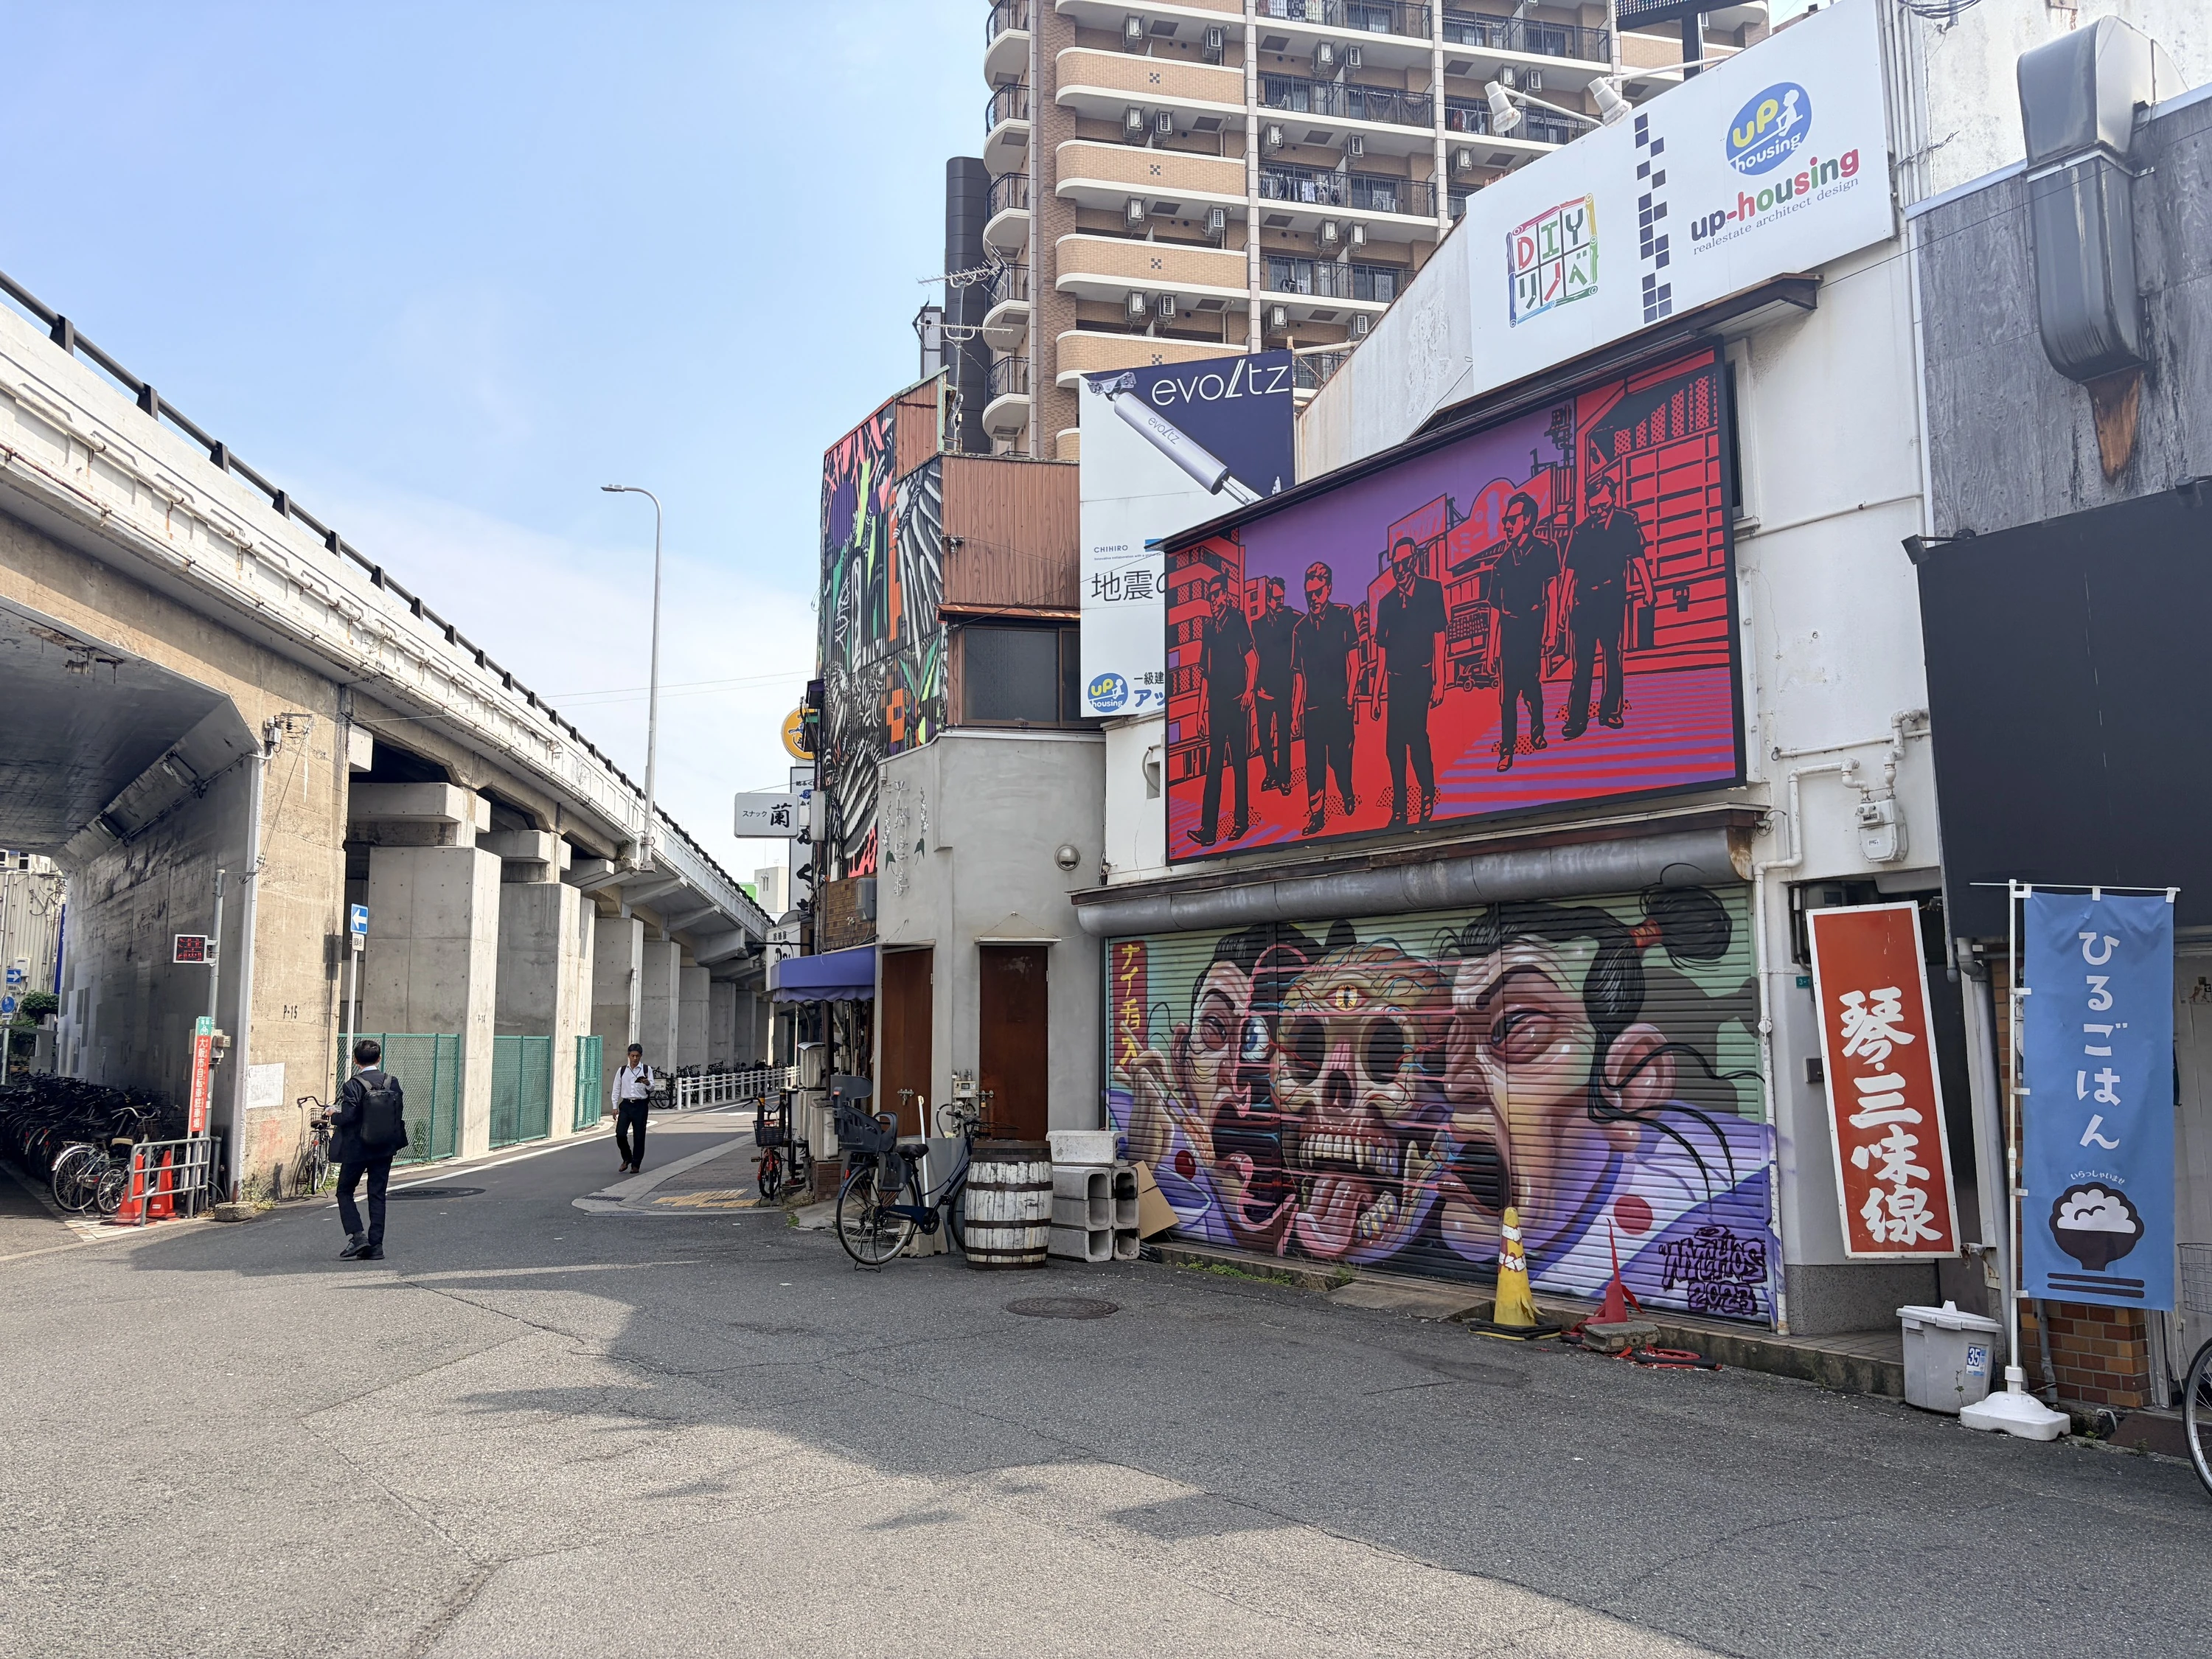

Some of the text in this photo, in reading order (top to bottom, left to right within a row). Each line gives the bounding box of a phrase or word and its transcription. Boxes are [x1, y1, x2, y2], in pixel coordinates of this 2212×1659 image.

[1736, 133, 1801, 171] housing
[1691, 149, 1859, 241] up-housing
[1694, 178, 1858, 255] realestate architect design
[1517, 208, 1583, 270] DIY
[1520, 250, 1587, 310] リノベ
[1094, 545, 1128, 553] CHIHIRO
[1134, 671, 1164, 685] 一級建
[1092, 700, 1123, 708] housing
[283, 1005, 298, 1019] P-15
[2077, 932, 2127, 1150] ひるごはん
[2070, 1170, 2125, 1185] いらっしゃいませ
[1968, 1348, 1980, 1366] 35
